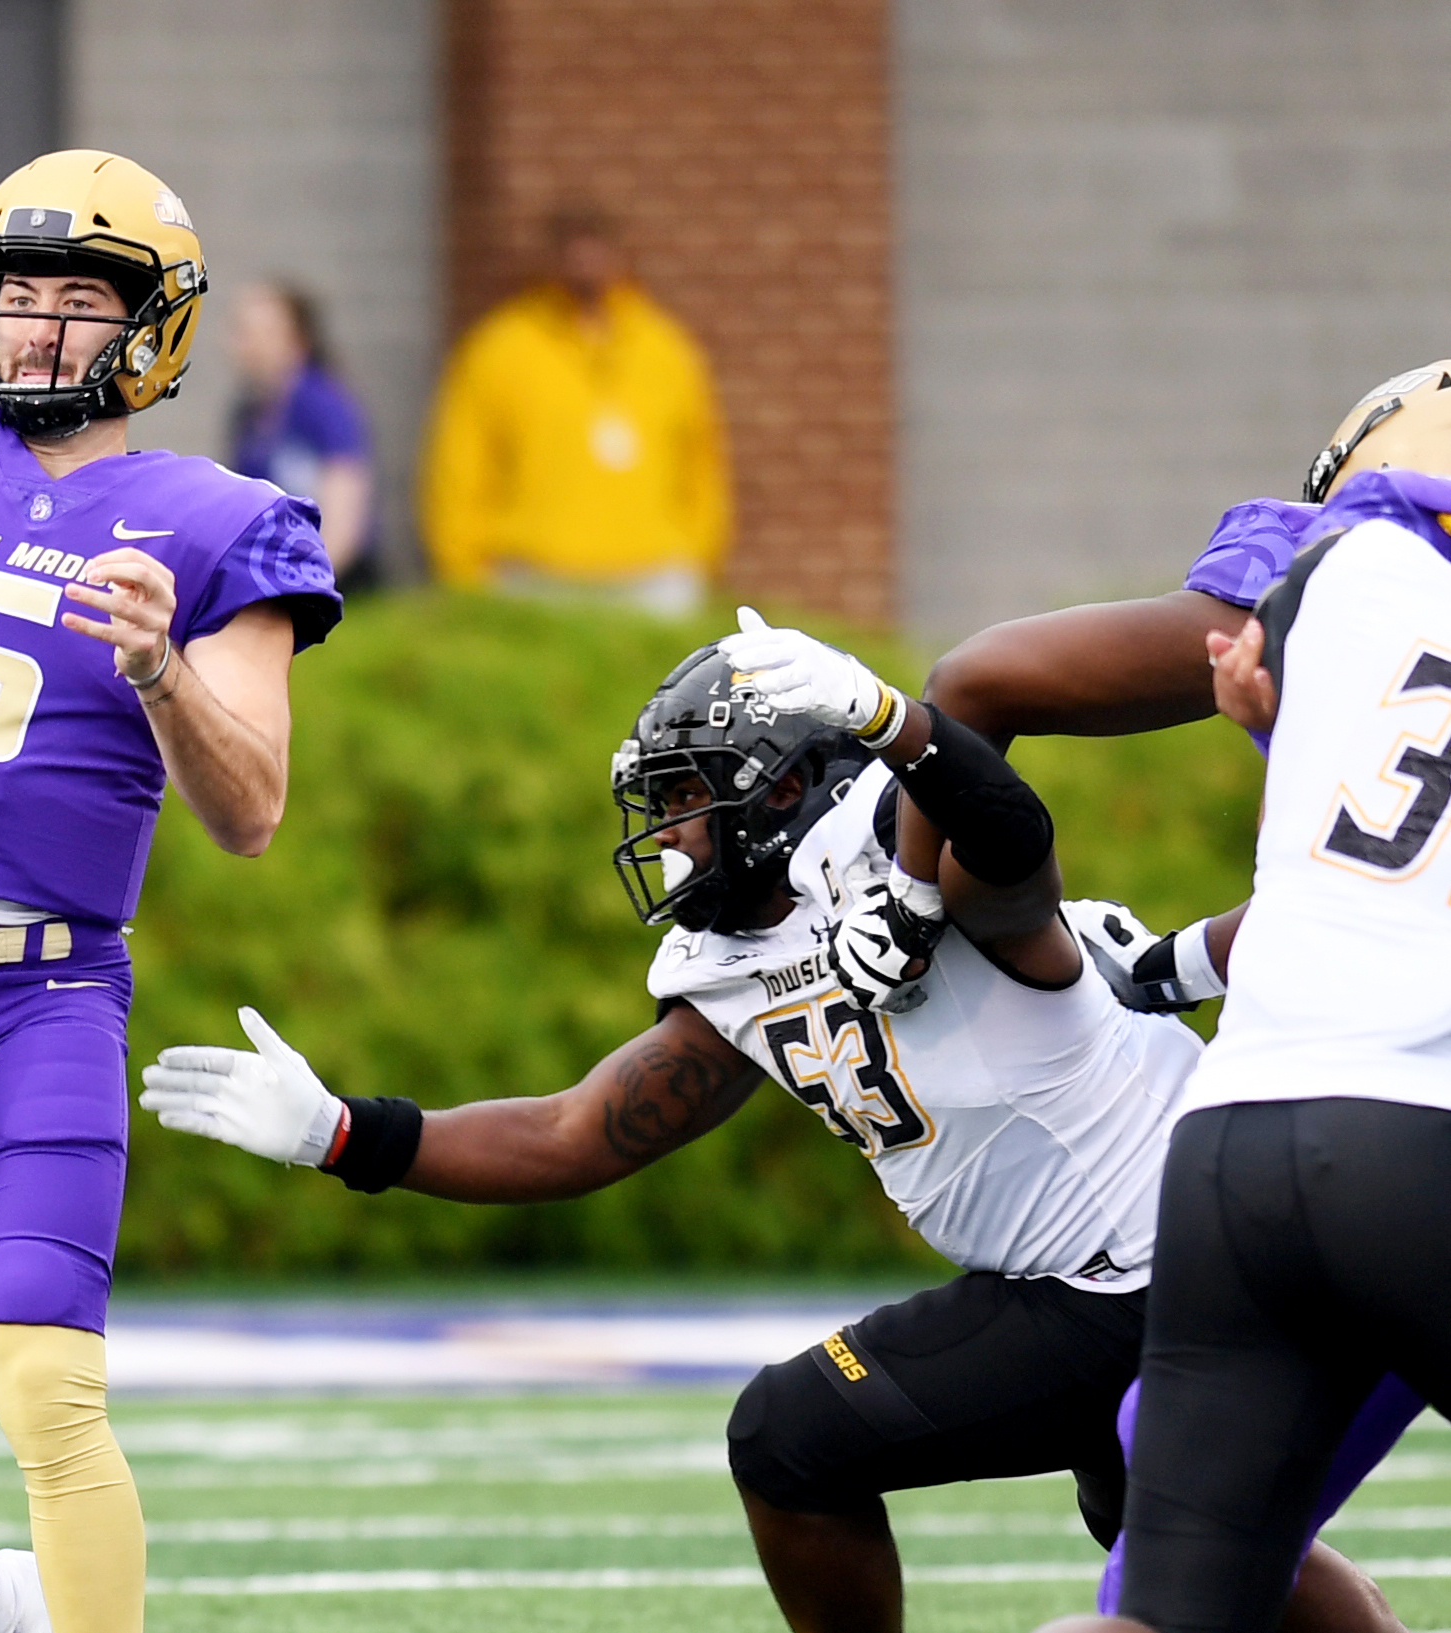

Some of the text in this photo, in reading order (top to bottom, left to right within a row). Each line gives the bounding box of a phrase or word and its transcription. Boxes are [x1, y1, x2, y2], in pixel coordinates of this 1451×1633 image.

[749, 953, 829, 1005] TOWS
[755, 989, 936, 1158] 53
[822, 1327, 869, 1382] GERS
